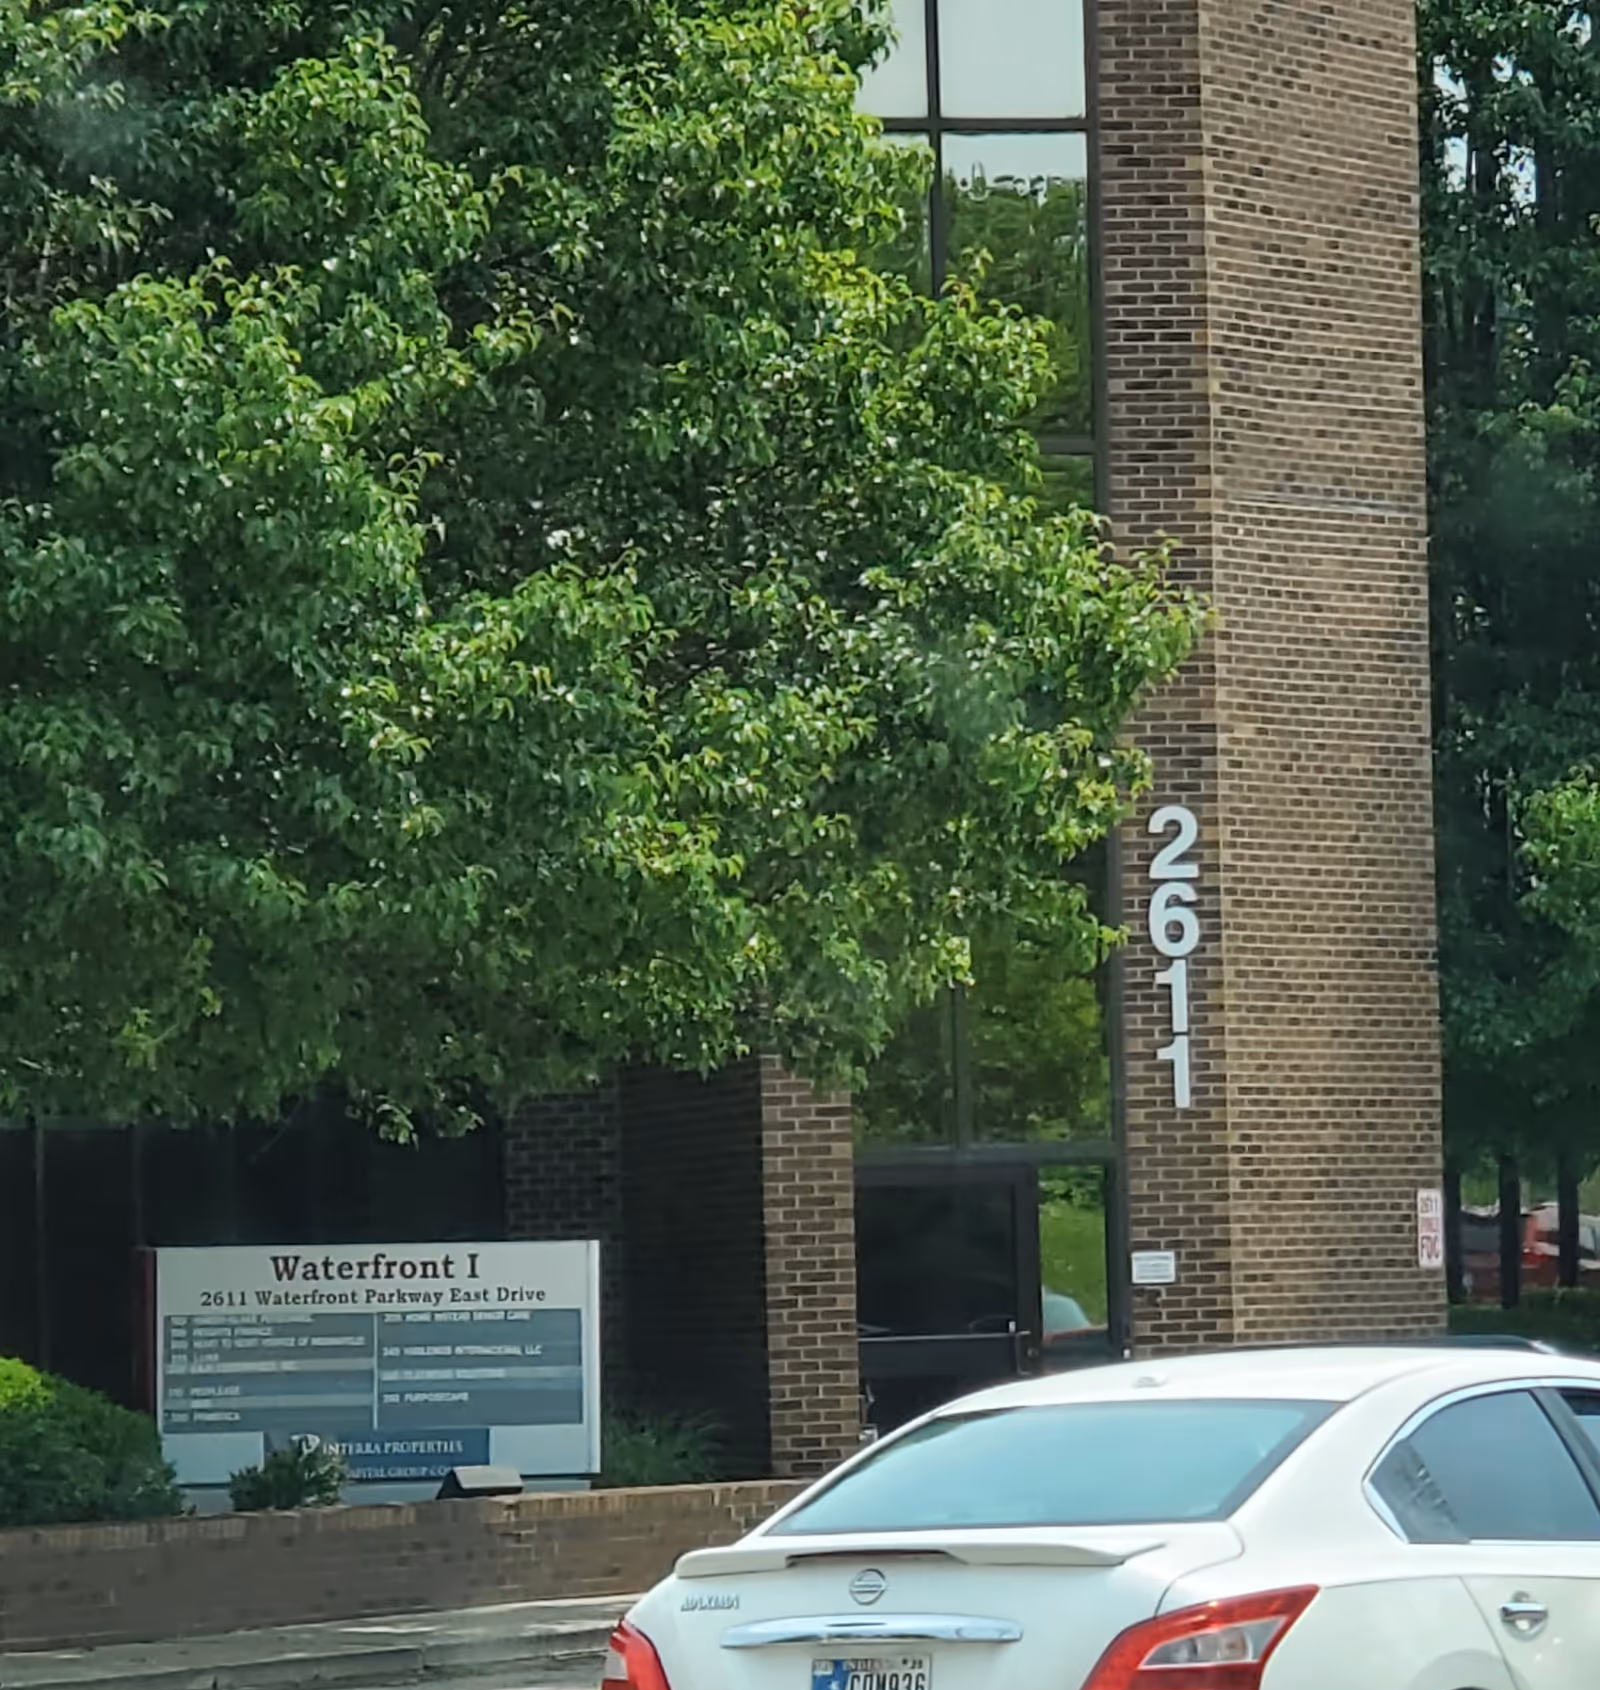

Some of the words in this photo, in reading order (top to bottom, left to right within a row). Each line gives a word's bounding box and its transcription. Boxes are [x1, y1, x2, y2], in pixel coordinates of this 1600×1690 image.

[1148, 805, 1200, 1109] 2611
[270, 1252, 455, 1281] Waterfront
[467, 1252, 480, 1279] I
[200, 1291, 247, 1306] 2611
[255, 1289, 358, 1305] Waterfront
[365, 1287, 444, 1307] Parkway
[449, 1288, 489, 1303] East
[496, 1286, 546, 1302] Drive
[322, 1441, 381, 1456] INTERRA
[384, 1440, 464, 1454] PROPERTIES
